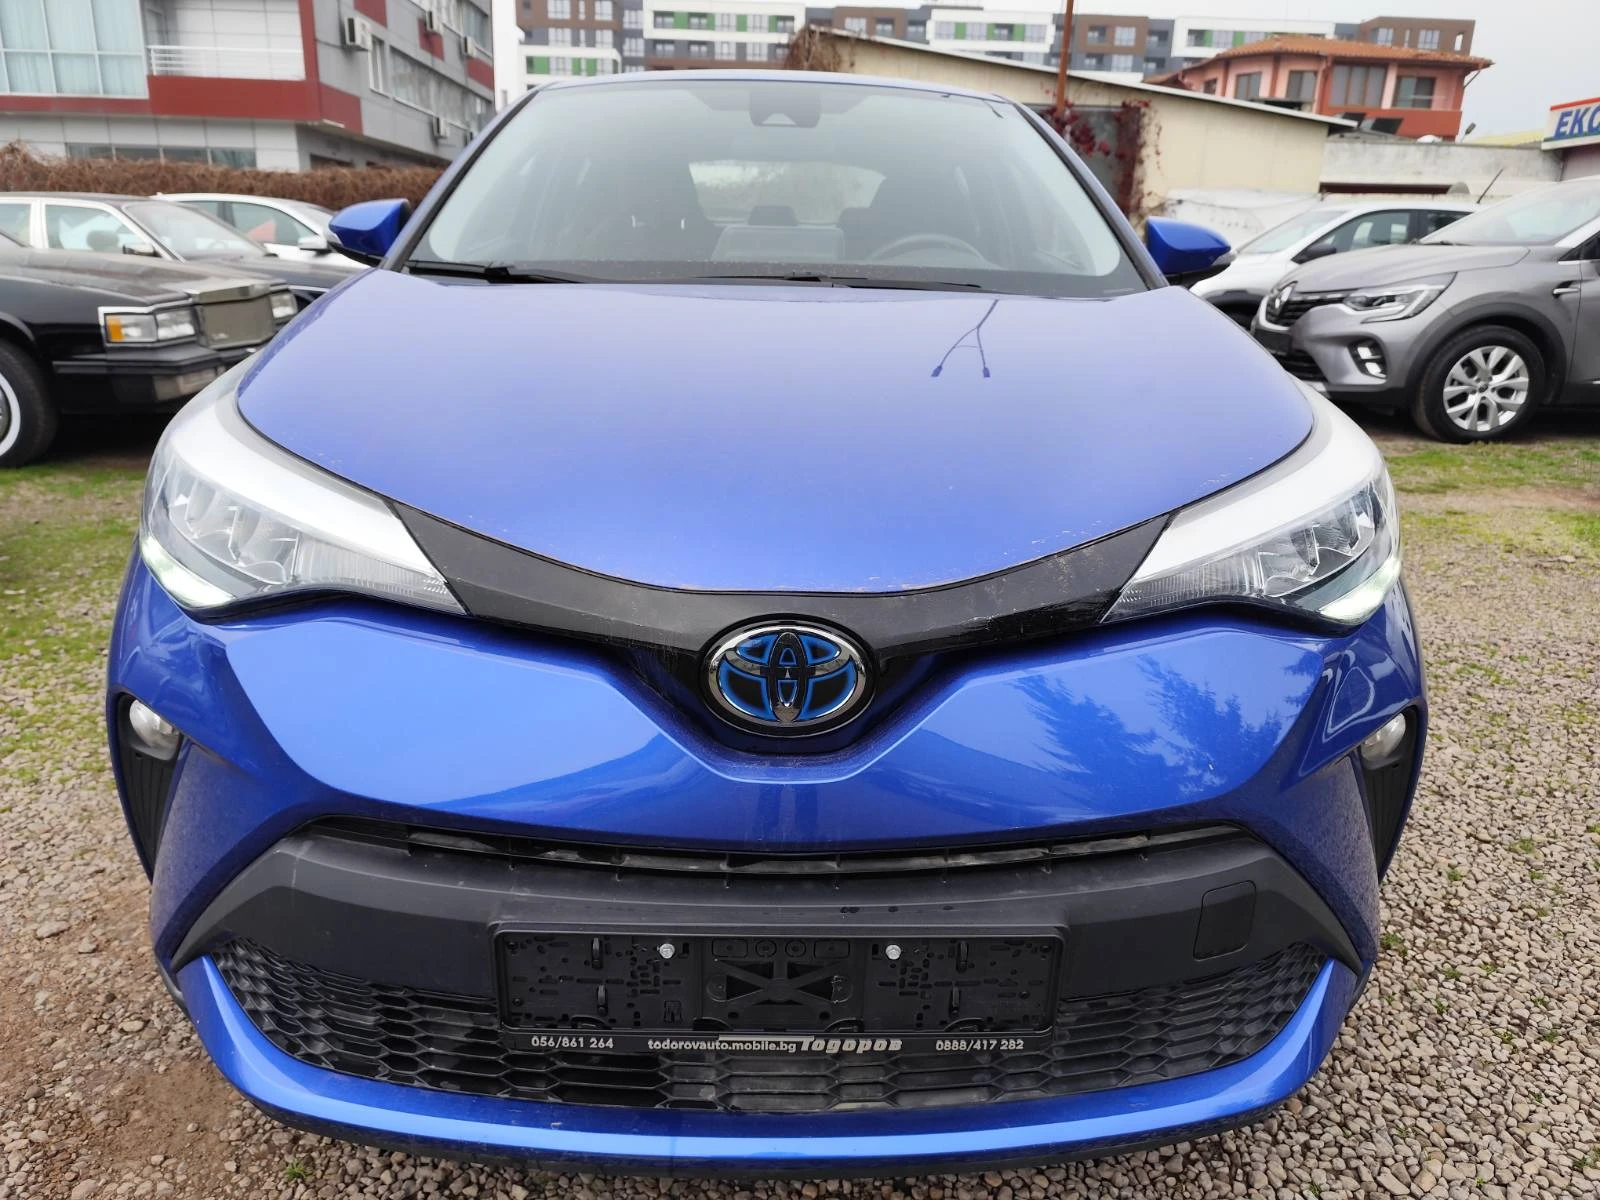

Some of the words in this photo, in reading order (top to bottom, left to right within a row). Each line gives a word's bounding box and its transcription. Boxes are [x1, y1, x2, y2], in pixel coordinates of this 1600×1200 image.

[531, 1035, 584, 1049] 056/861
[589, 1037, 614, 1049] 264
[647, 1038, 796, 1053] todorovauto.mobile.bg
[935, 1039, 998, 1052] 0888/417
[1000, 1038, 1025, 1050] 282
